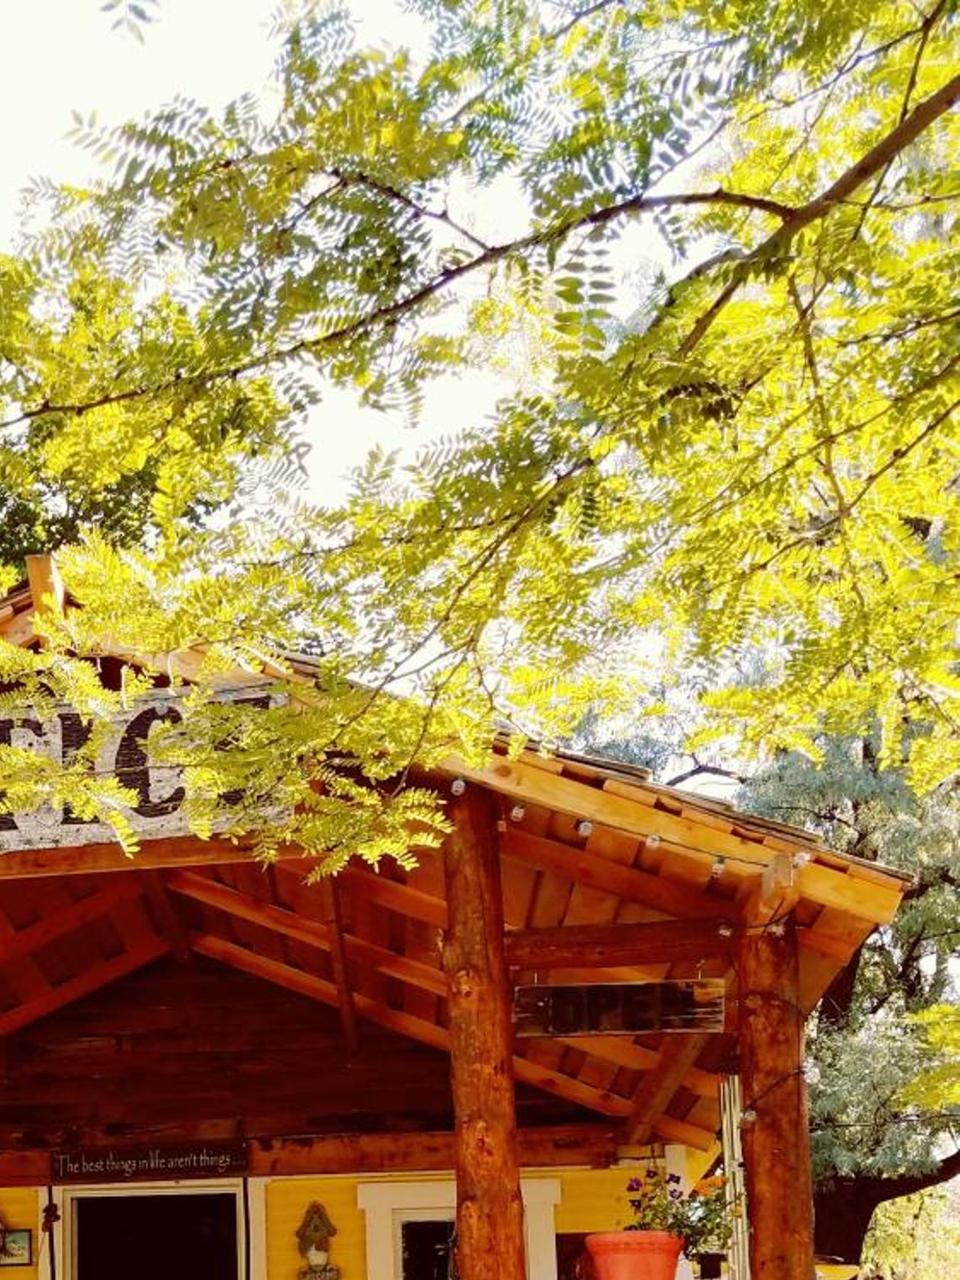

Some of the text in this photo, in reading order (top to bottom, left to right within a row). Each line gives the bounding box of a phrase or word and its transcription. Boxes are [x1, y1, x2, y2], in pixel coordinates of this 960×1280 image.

[55, 1153, 79, 1177] The
[82, 1152, 104, 1173] best
[106, 1152, 136, 1177] things
[138, 1158, 148, 1169] in
[168, 1153, 196, 1169] aren't
[200, 1147, 231, 1174] things
